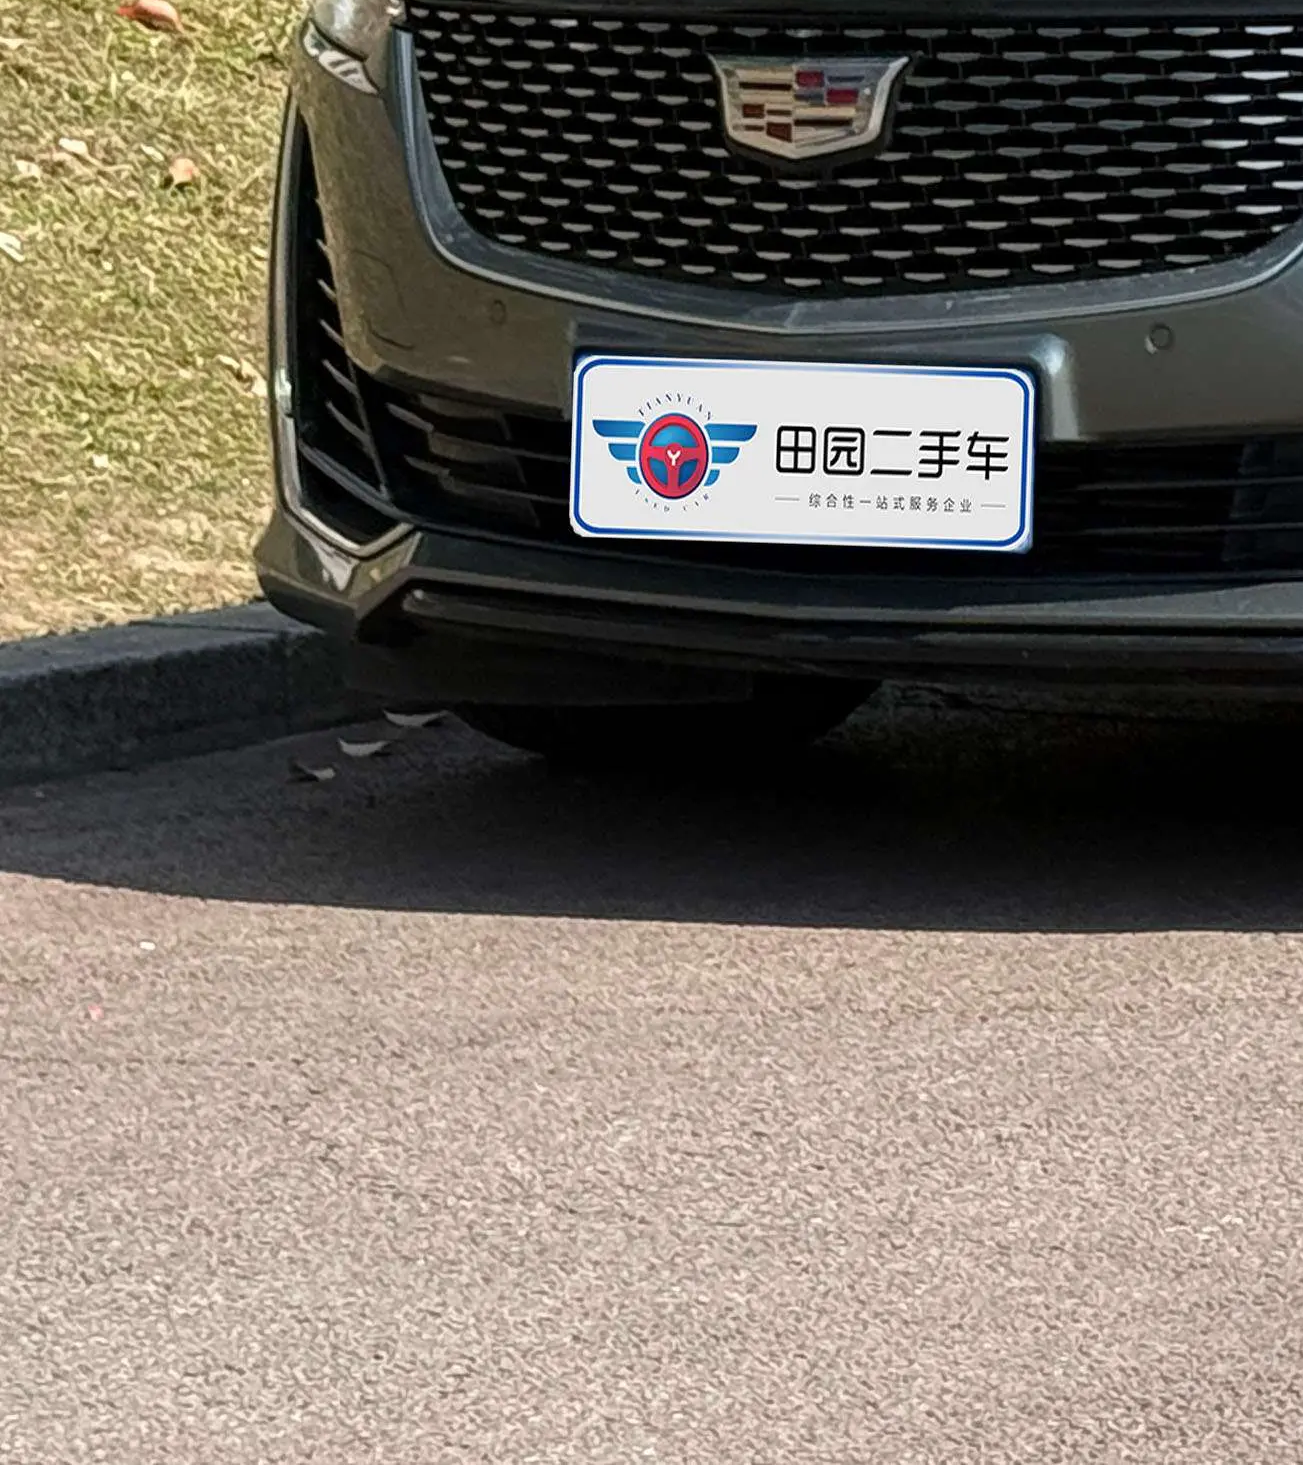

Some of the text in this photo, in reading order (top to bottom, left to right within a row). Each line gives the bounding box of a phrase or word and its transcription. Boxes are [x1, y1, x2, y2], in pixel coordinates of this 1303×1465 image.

[775, 424, 1010, 481] 田园二手车
[808, 491, 973, 513] 综合性一站式服务企业
